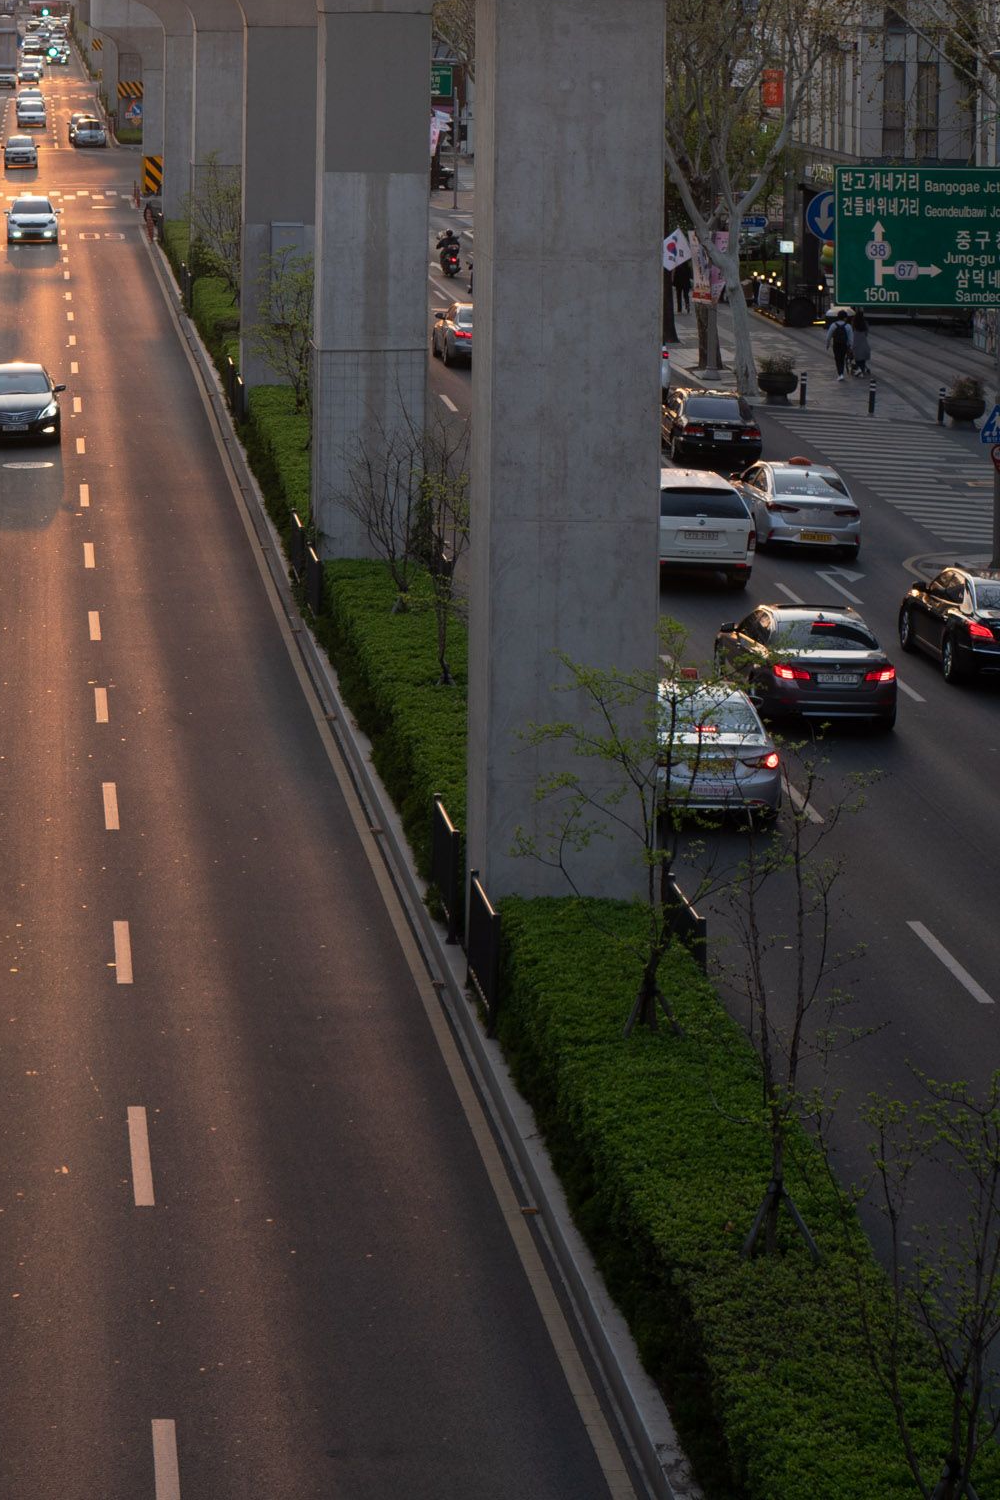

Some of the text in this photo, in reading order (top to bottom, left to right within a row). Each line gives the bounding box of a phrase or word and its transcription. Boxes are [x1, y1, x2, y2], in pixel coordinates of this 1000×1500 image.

[841, 172, 920, 192] 반고개네거리
[924, 180, 980, 195] Bangogae
[842, 197, 920, 216] 건들바위네거리
[925, 205, 987, 217] Geondeulbawi
[956, 231, 991, 250] 중구
[870, 244, 886, 257] 38
[943, 252, 995, 266] Jung-gu
[897, 264, 914, 276] 67
[864, 288, 900, 302] 150m
